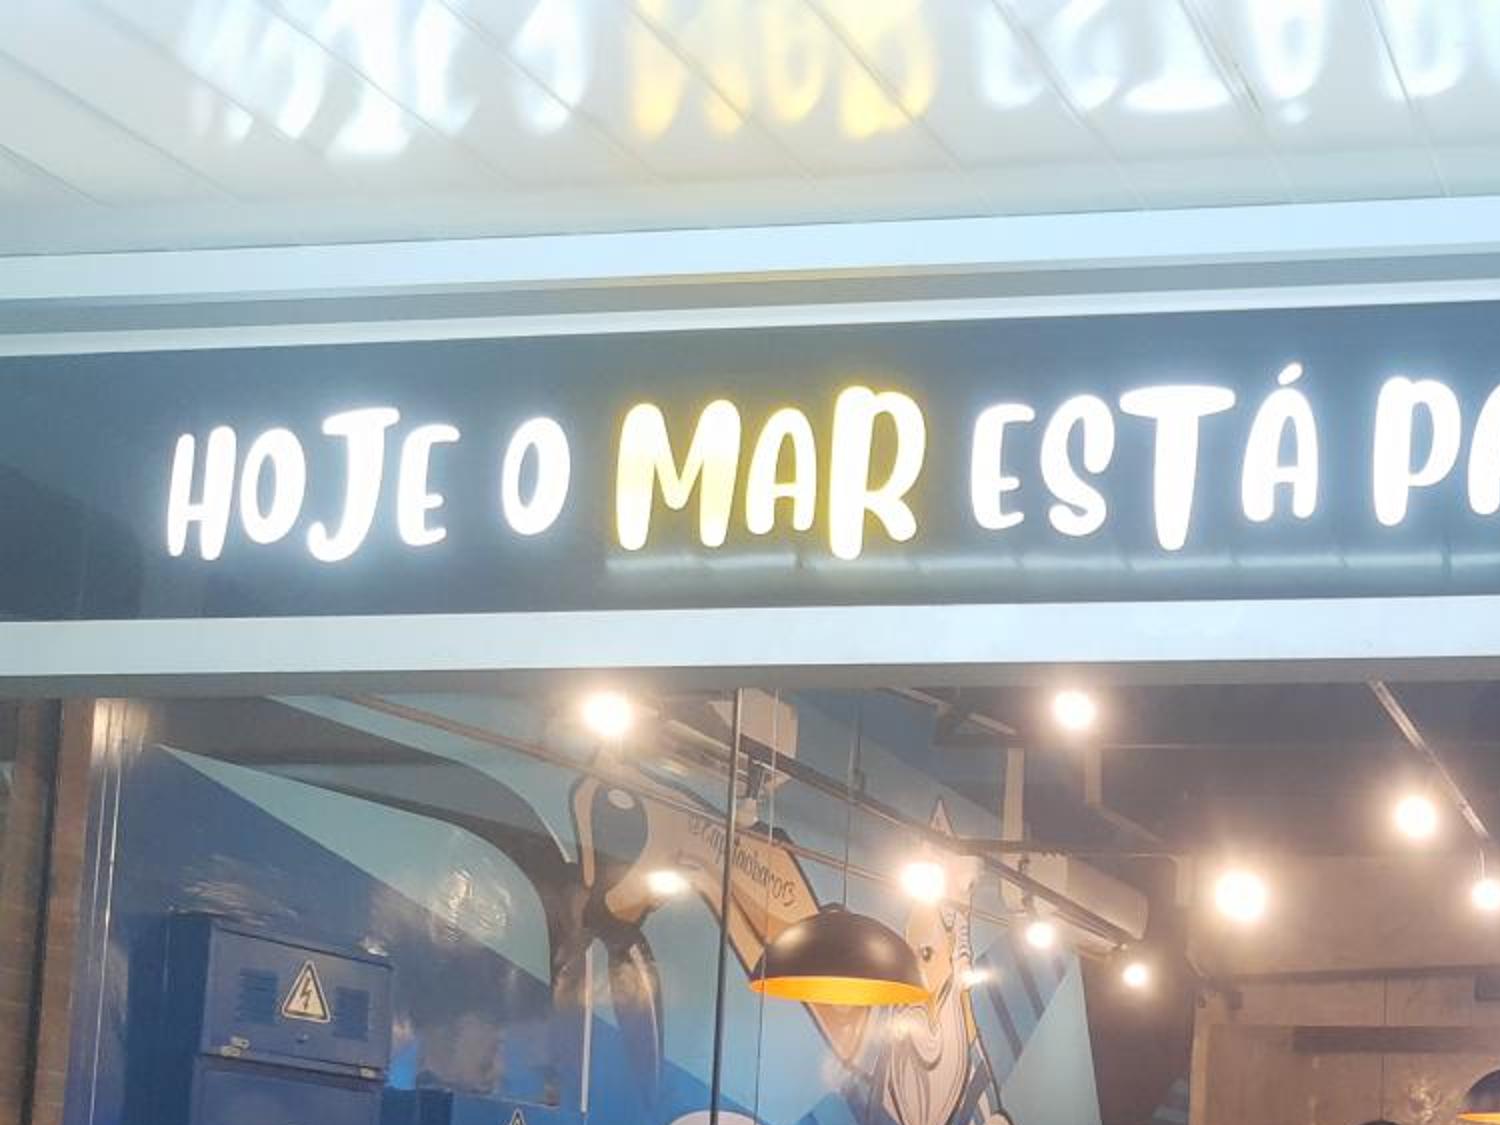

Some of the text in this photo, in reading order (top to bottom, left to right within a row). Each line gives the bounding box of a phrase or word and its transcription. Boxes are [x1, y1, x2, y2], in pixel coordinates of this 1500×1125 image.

[166, 405, 461, 563] HOJE
[502, 416, 572, 536] O
[615, 385, 927, 562] MAR
[970, 363, 1320, 551] ESTÁ
